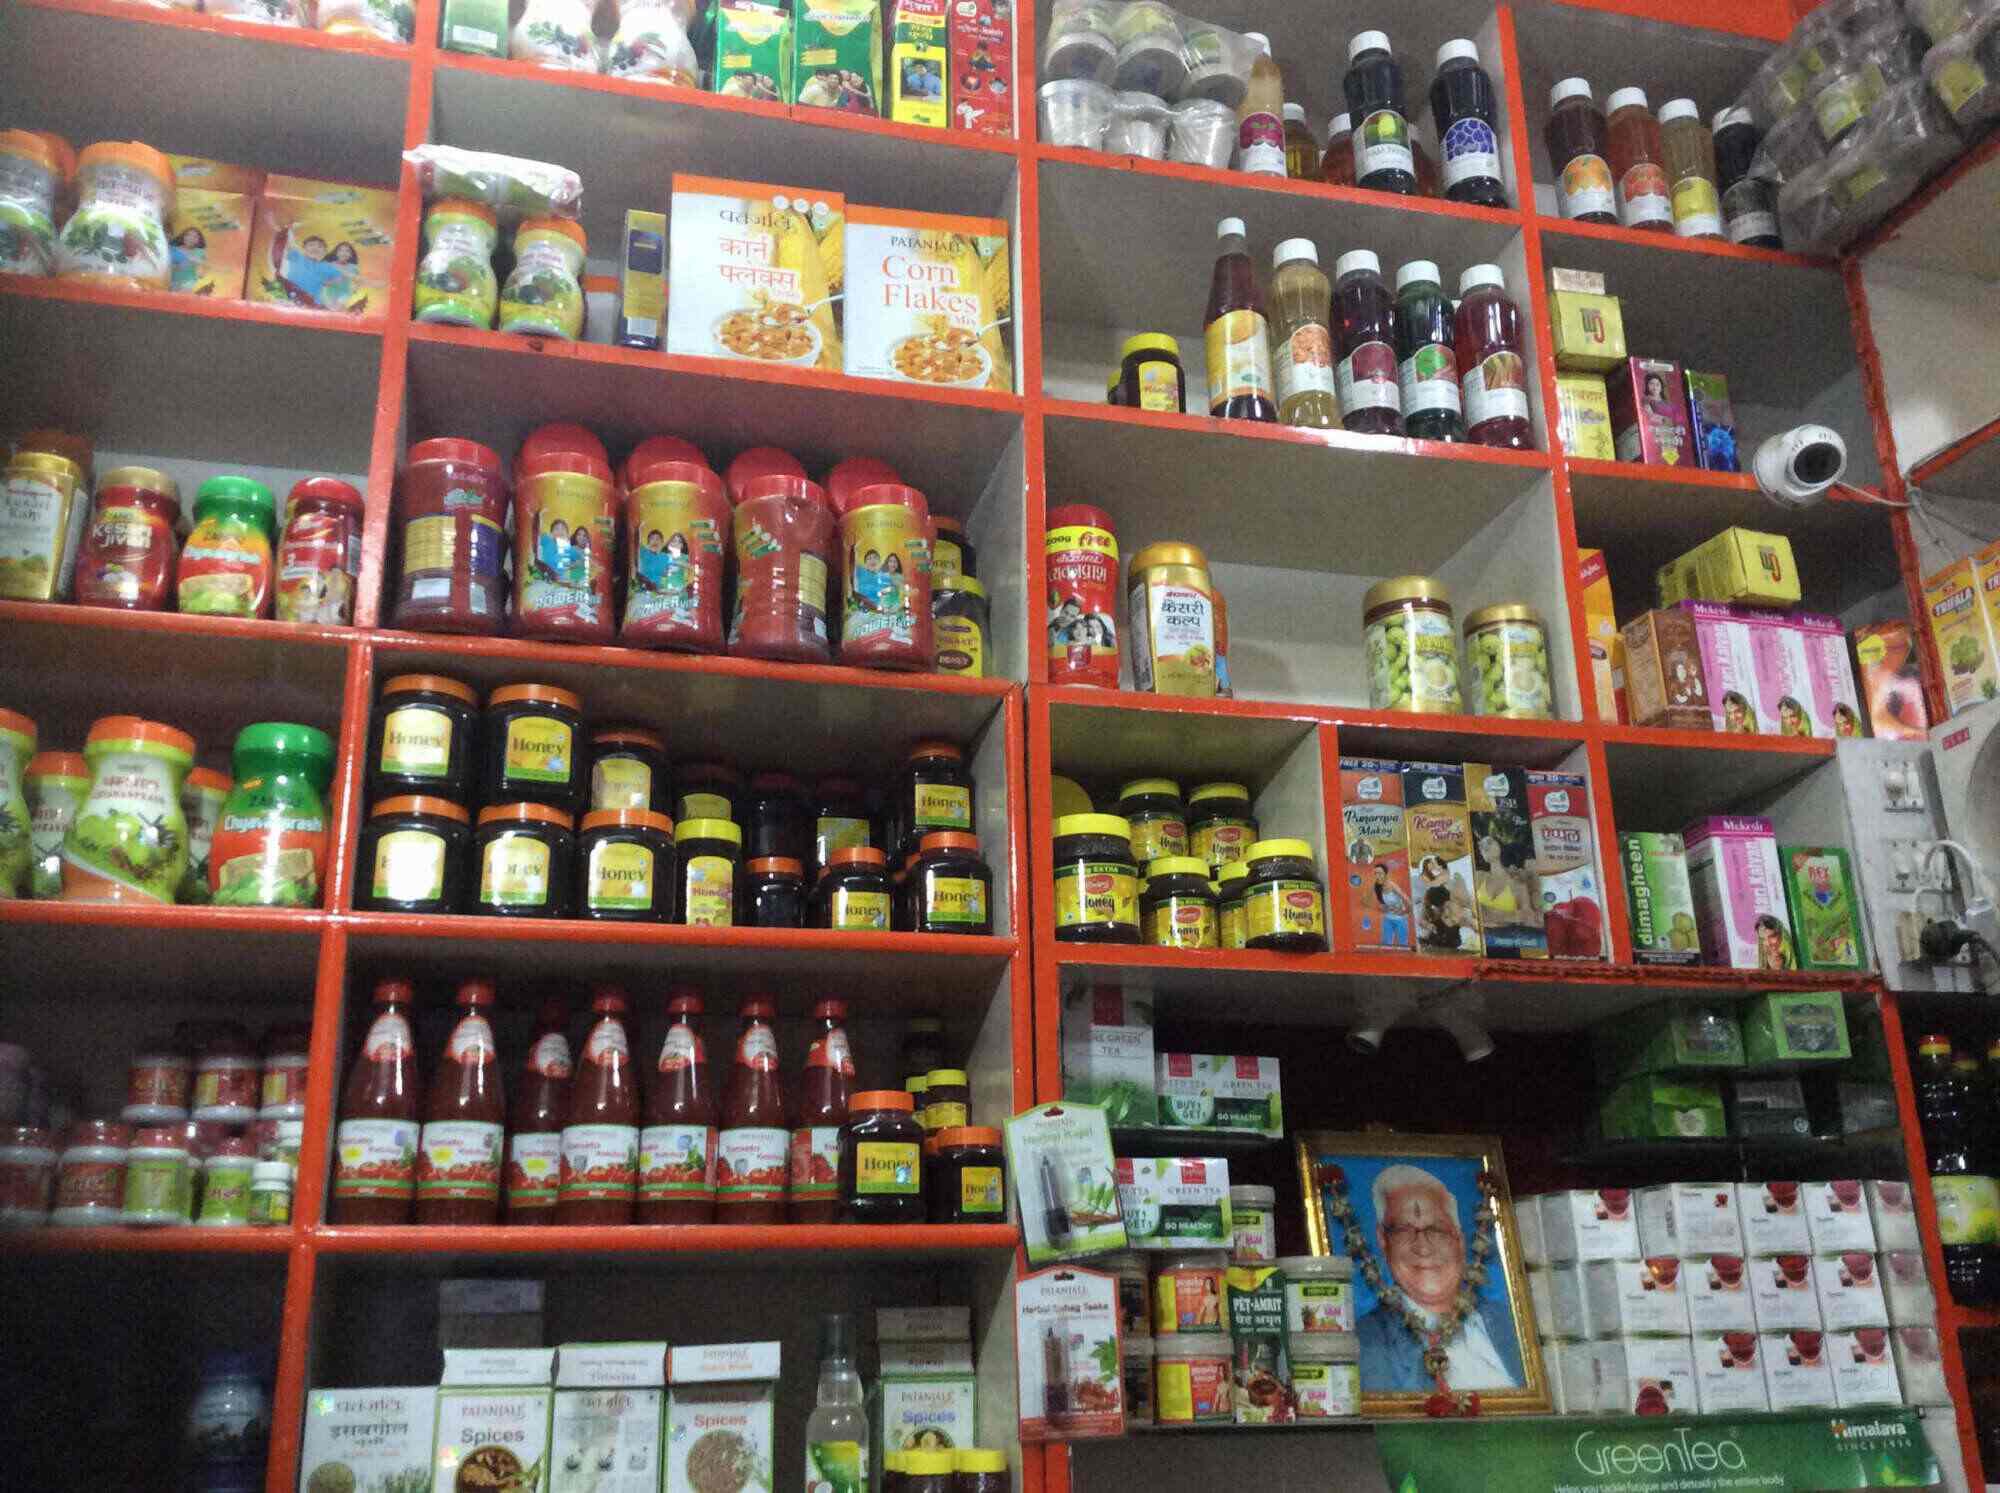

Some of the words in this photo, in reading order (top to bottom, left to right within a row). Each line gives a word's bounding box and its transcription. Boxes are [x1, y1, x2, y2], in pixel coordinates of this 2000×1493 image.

[881, 254, 957, 284] Corn
[881, 283, 978, 314] Flakes
[512, 737, 565, 755] Honey
[1723, 819, 1764, 833] Mukesh
[1627, 839, 1653, 946] dimagheen
[1216, 1112, 1228, 1121] GO
[864, 1156, 913, 1172] Honey
[1165, 1222, 1177, 1231] GO
[694, 1413, 749, 1429] Spices
[902, 1410, 956, 1426] Spices
[461, 1427, 526, 1446] Spices
